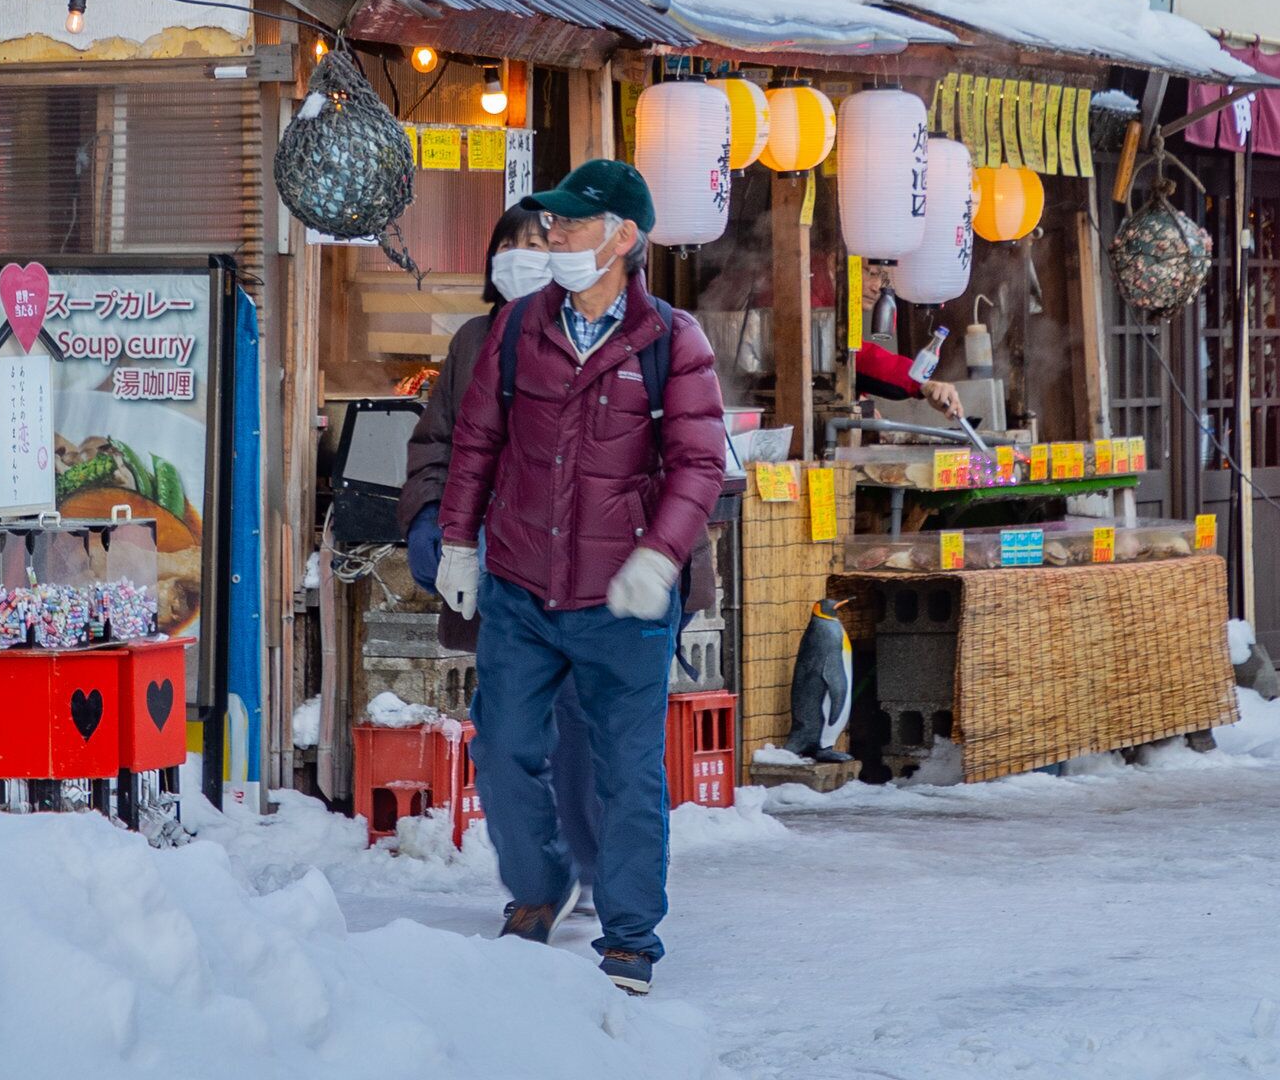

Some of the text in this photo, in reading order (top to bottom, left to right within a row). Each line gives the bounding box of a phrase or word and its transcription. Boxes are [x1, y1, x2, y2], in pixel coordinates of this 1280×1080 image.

[15, 289, 36, 303] 世界一
[46, 289, 192, 317] スープカレー
[58, 331, 192, 363] Soup curry
